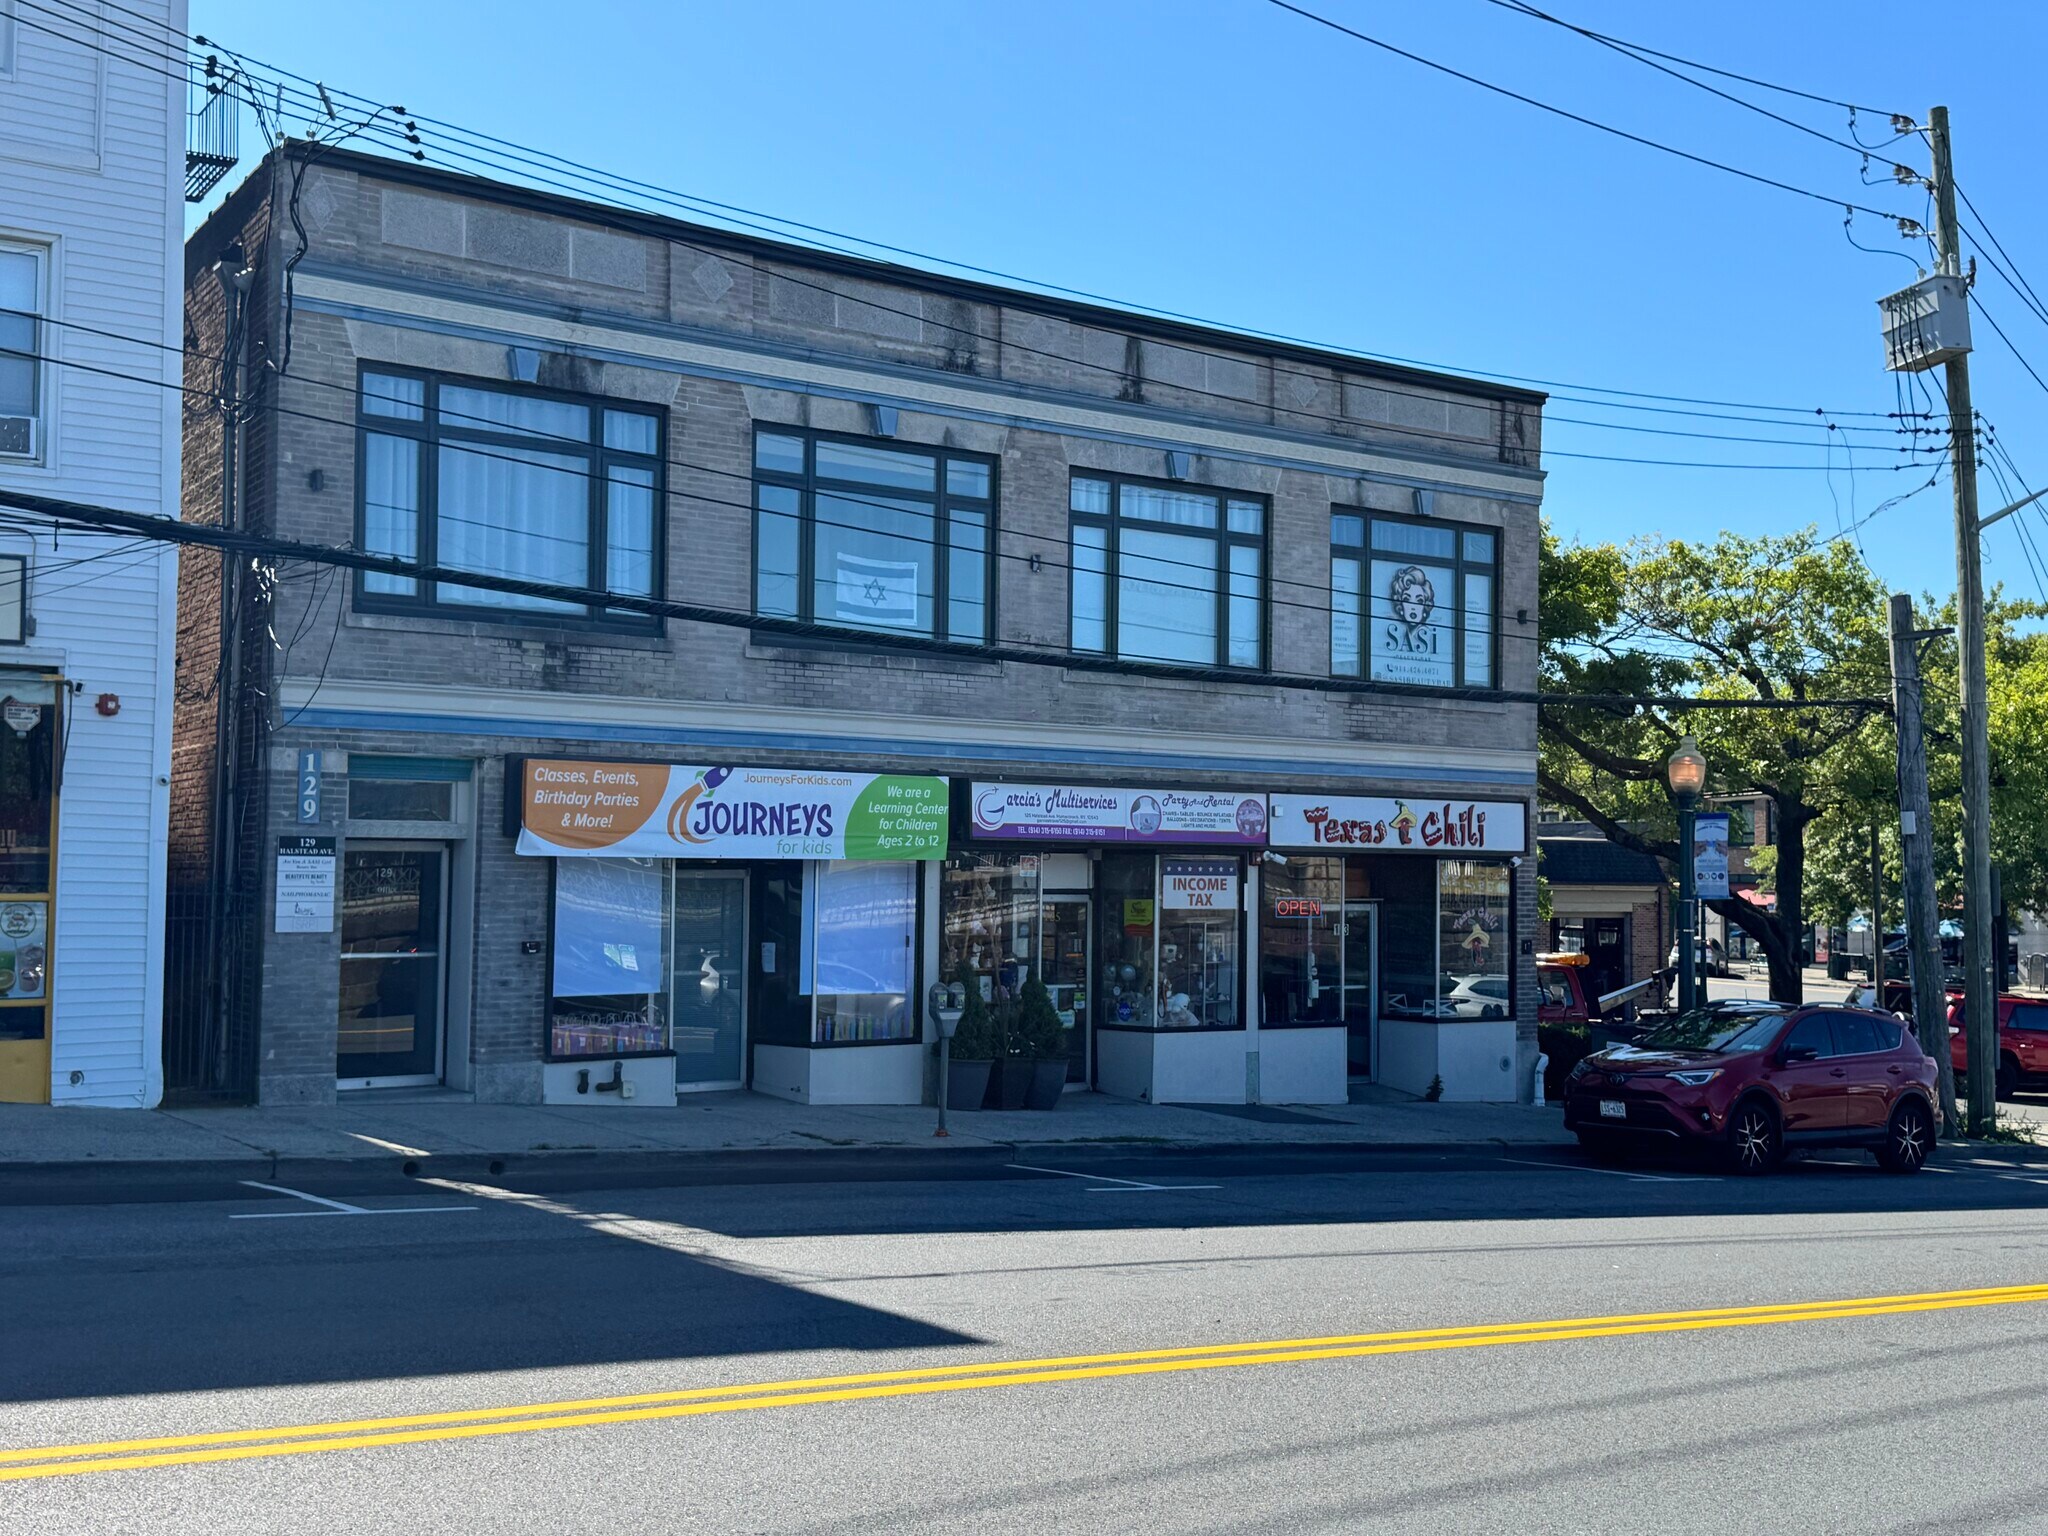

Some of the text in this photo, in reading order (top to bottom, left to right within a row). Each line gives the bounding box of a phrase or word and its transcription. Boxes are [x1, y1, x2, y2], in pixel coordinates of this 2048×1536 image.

[534, 767, 639, 787] Classes, Events,
[744, 773, 852, 787] JourneysForKids.com
[303, 753, 317, 818] 129
[887, 785, 931, 798] We are a
[534, 790, 639, 808] Birthday Parties
[1045, 789, 1118, 813] Multiservices
[1162, 793, 1189, 809] Party
[1203, 794, 1235, 808] Rental
[868, 802, 948, 816] Learning Center
[561, 813, 613, 828] & More!
[693, 800, 833, 837] JOURNEYS
[879, 818, 937, 831] for Children
[1303, 804, 1486, 847] Texas Chili
[300, 838, 316, 847] 129
[776, 839, 832, 855] for kids
[877, 835, 939, 848] Ages 2 to 12
[376, 868, 393, 878] 129
[1172, 877, 1227, 891] INCOME
[1187, 893, 1213, 906] TAX
[1277, 900, 1320, 915] OPEN
